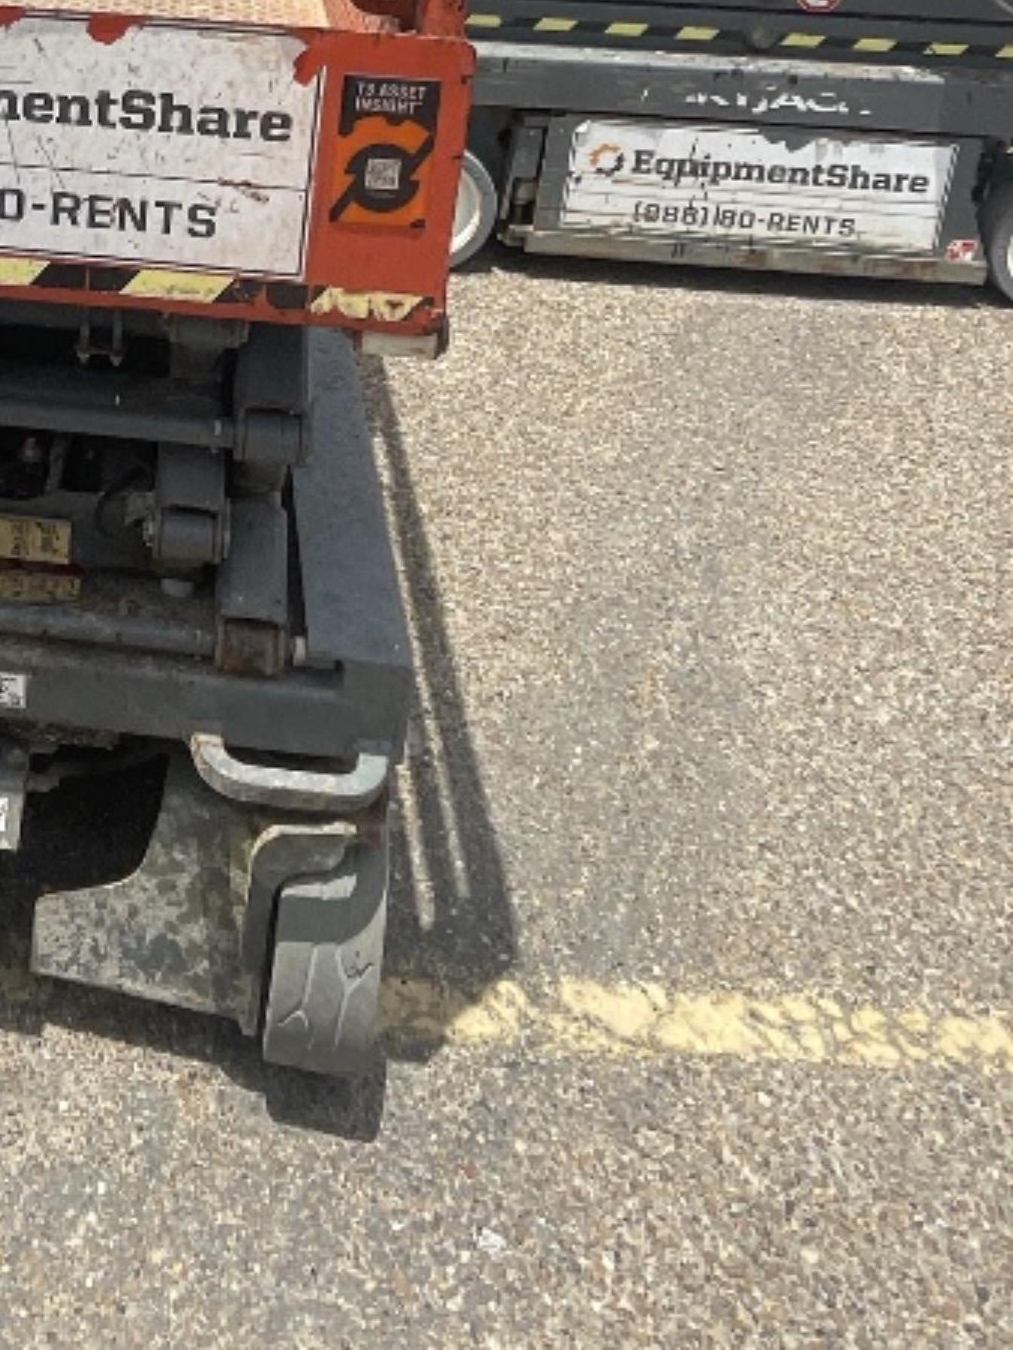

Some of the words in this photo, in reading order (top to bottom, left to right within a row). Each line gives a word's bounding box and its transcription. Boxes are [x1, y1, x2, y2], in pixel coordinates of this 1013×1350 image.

[378, 82, 427, 100] ASSET
[631, 149, 930, 195] EquipmentShare
[720, 208, 856, 237] 80-RENTS
